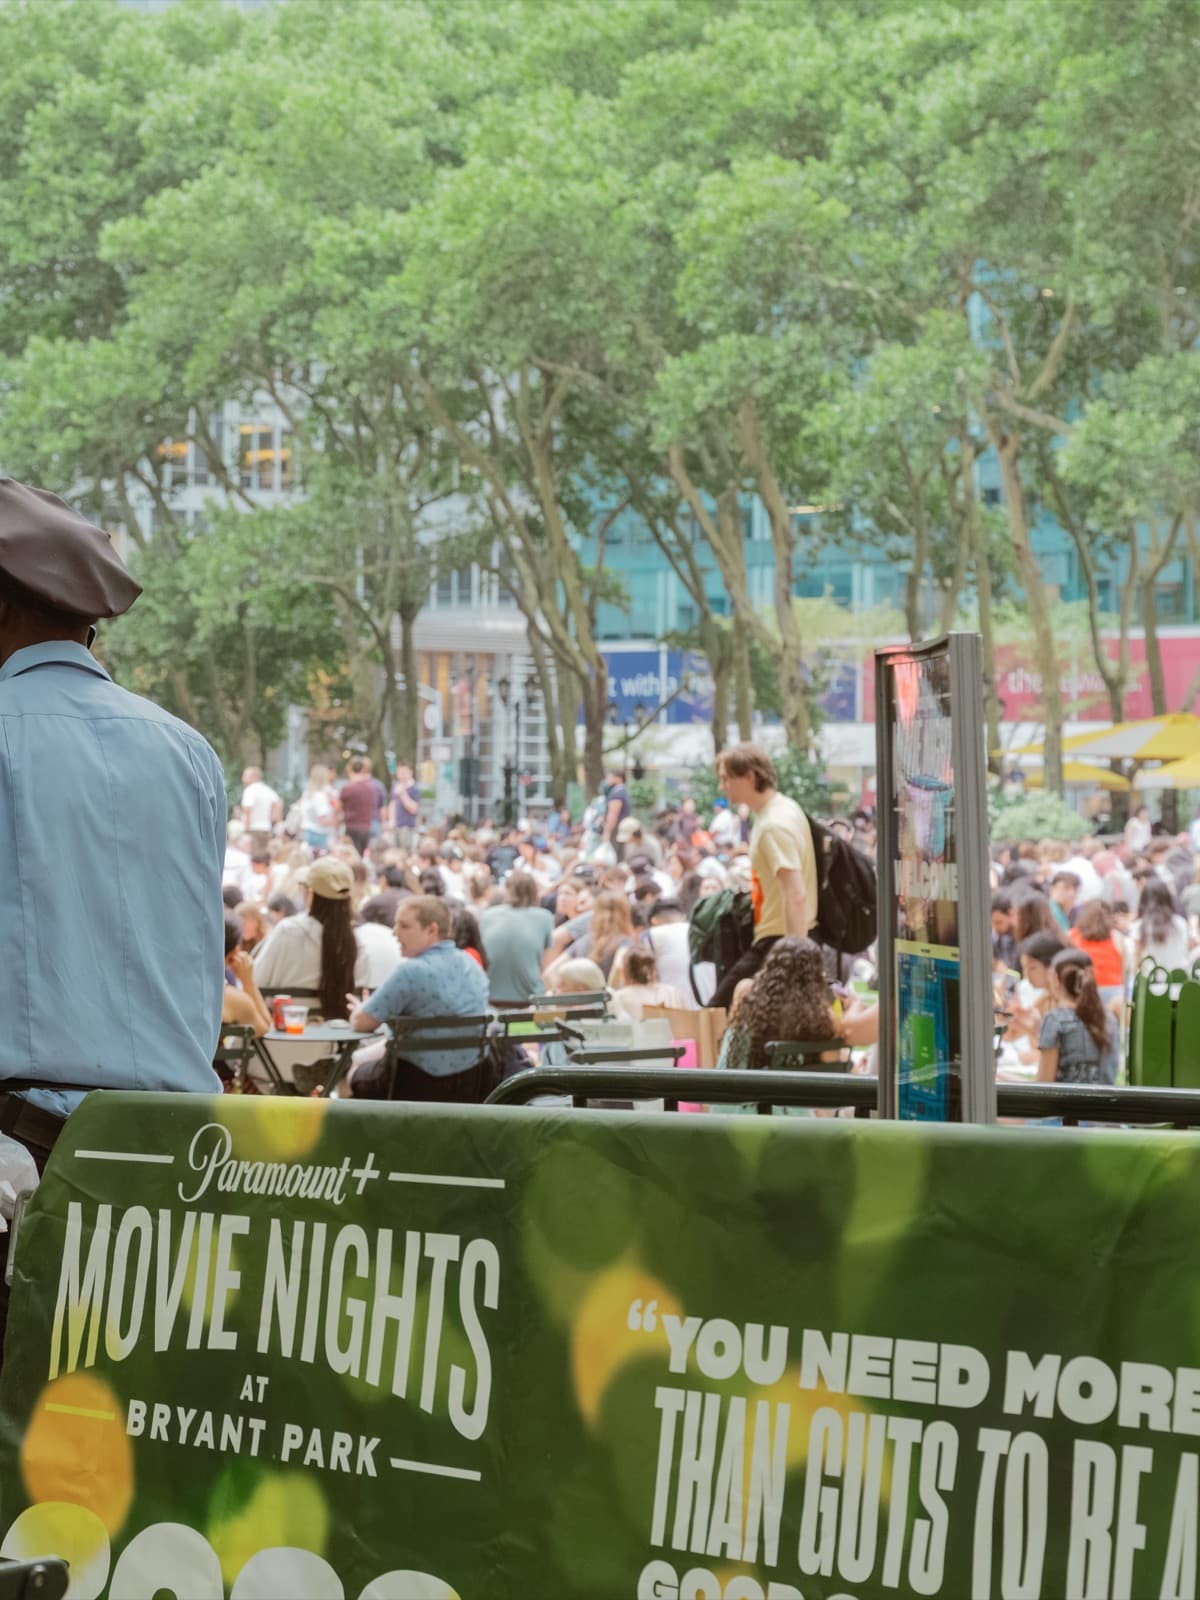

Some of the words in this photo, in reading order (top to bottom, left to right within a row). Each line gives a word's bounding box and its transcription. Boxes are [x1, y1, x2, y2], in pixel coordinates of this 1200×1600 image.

[893, 859, 959, 902] WELCOME
[178, 1123, 380, 1205] Paramount+
[48, 1201, 250, 1380] MOVIE
[257, 1218, 501, 1441] NIGHTS
[240, 1375, 269, 1403] AT
[799, 1328, 990, 1408] NEED
[1003, 1350, 1200, 1436] MORE
[125, 1399, 267, 1456] BRYANT
[280, 1424, 381, 1477] PARK
[650, 1386, 791, 1567] THAN
[798, 1406, 958, 1595] GUTS
[971, 1428, 1048, 1600] TO
[1065, 1439, 1153, 1600] BE
